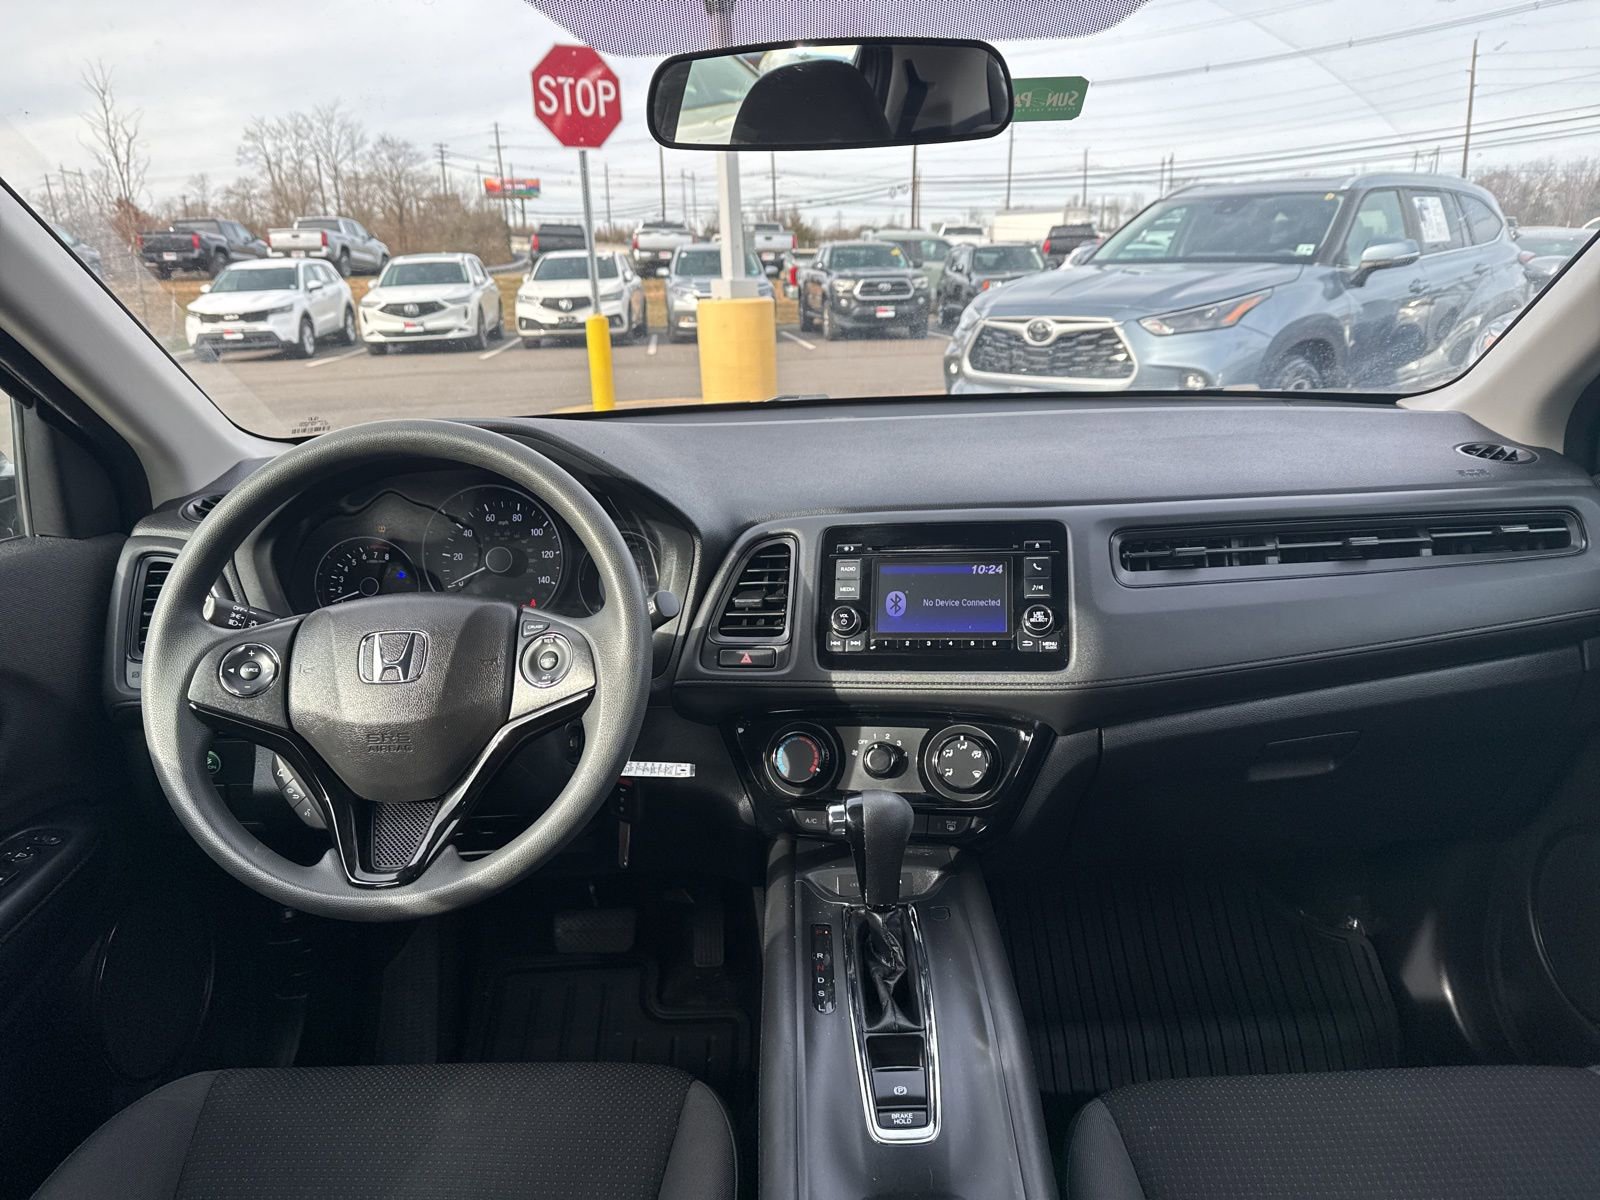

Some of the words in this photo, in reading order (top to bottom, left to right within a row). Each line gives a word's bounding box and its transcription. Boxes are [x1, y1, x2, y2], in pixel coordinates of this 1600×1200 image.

[538, 75, 616, 117] STOP
[485, 513, 495, 522] 60
[512, 513, 522, 522] 80
[463, 529, 473, 538] 40
[530, 528, 543, 537] 100
[362, 553, 367, 561] 6
[373, 551, 379, 559] 7
[384, 553, 390, 561] 8
[453, 552, 463, 561] 20
[541, 550, 554, 559] 120
[343, 565, 349, 573] 4
[971, 564, 1003, 575] 10:24
[339, 575, 344, 583] 3
[537, 576, 551, 585] 140
[337, 586, 343, 594] 2
[922, 598, 934, 607] No
[935, 598, 960, 607] Device
[961, 598, 1001, 607] Connected
[818, 1003, 826, 1012] L
[891, 1112, 914, 1120] BRAKE
